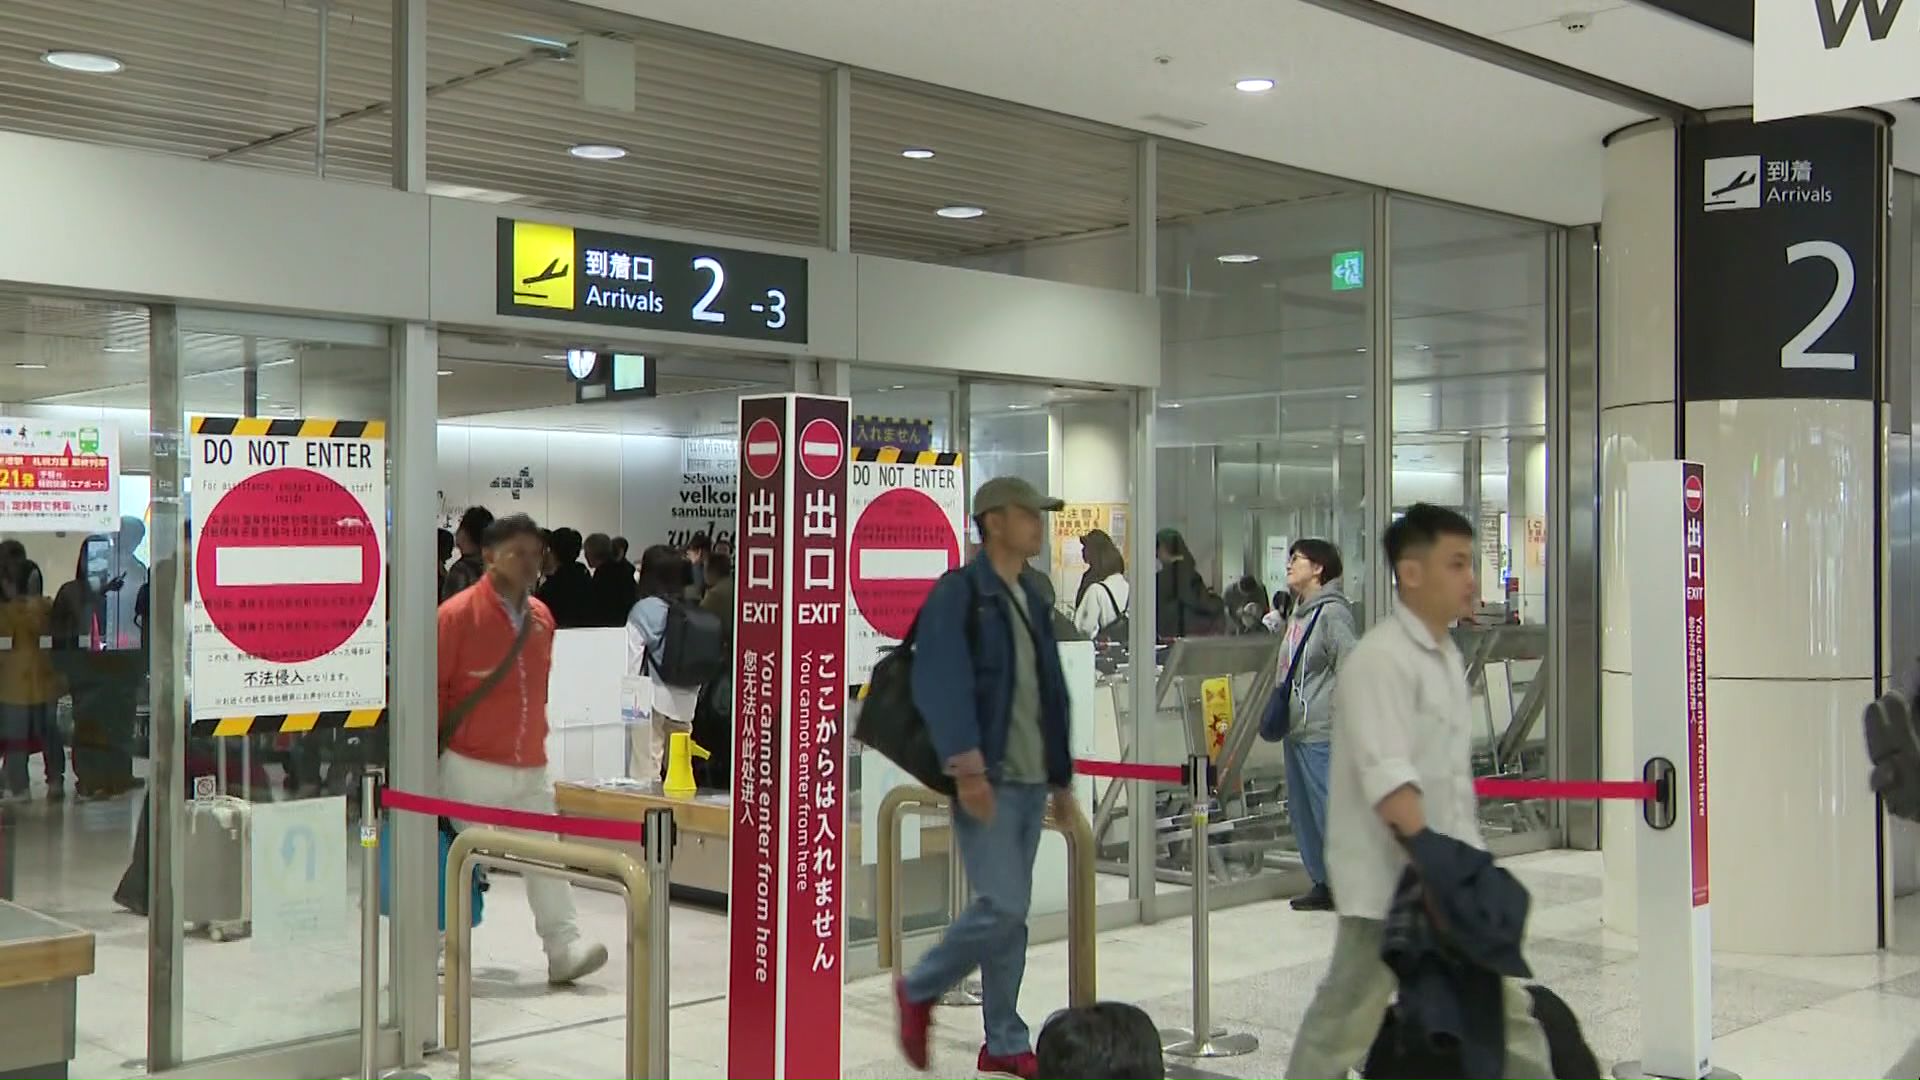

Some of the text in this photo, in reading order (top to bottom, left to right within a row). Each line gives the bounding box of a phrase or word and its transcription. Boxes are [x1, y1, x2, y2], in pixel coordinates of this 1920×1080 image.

[1767, 160, 1813, 183] 到着
[1767, 185, 1832, 203] Arrivals
[585, 250, 654, 283] 到着口
[585, 284, 664, 314] Arrivals
[690, 257, 786, 329] 2 -3
[1780, 240, 1857, 371] 2
[857, 425, 921, 444] 入れません
[204, 439, 372, 468] DO NOT ENTER
[853, 465, 955, 489] DO NOT ENTER
[748, 489, 776, 590] 出口
[803, 489, 838, 590] 出口
[1687, 517, 1701, 579] 出口
[1687, 587, 1704, 600] EXIT
[743, 602, 779, 625] EXIT
[798, 602, 840, 625] EXIT
[1696, 648, 1704, 698] cannot
[797, 651, 813, 891] You cannot enter from here
[755, 652, 775, 983] You cannot enter from here
[812, 653, 838, 973] ここからは入れません
